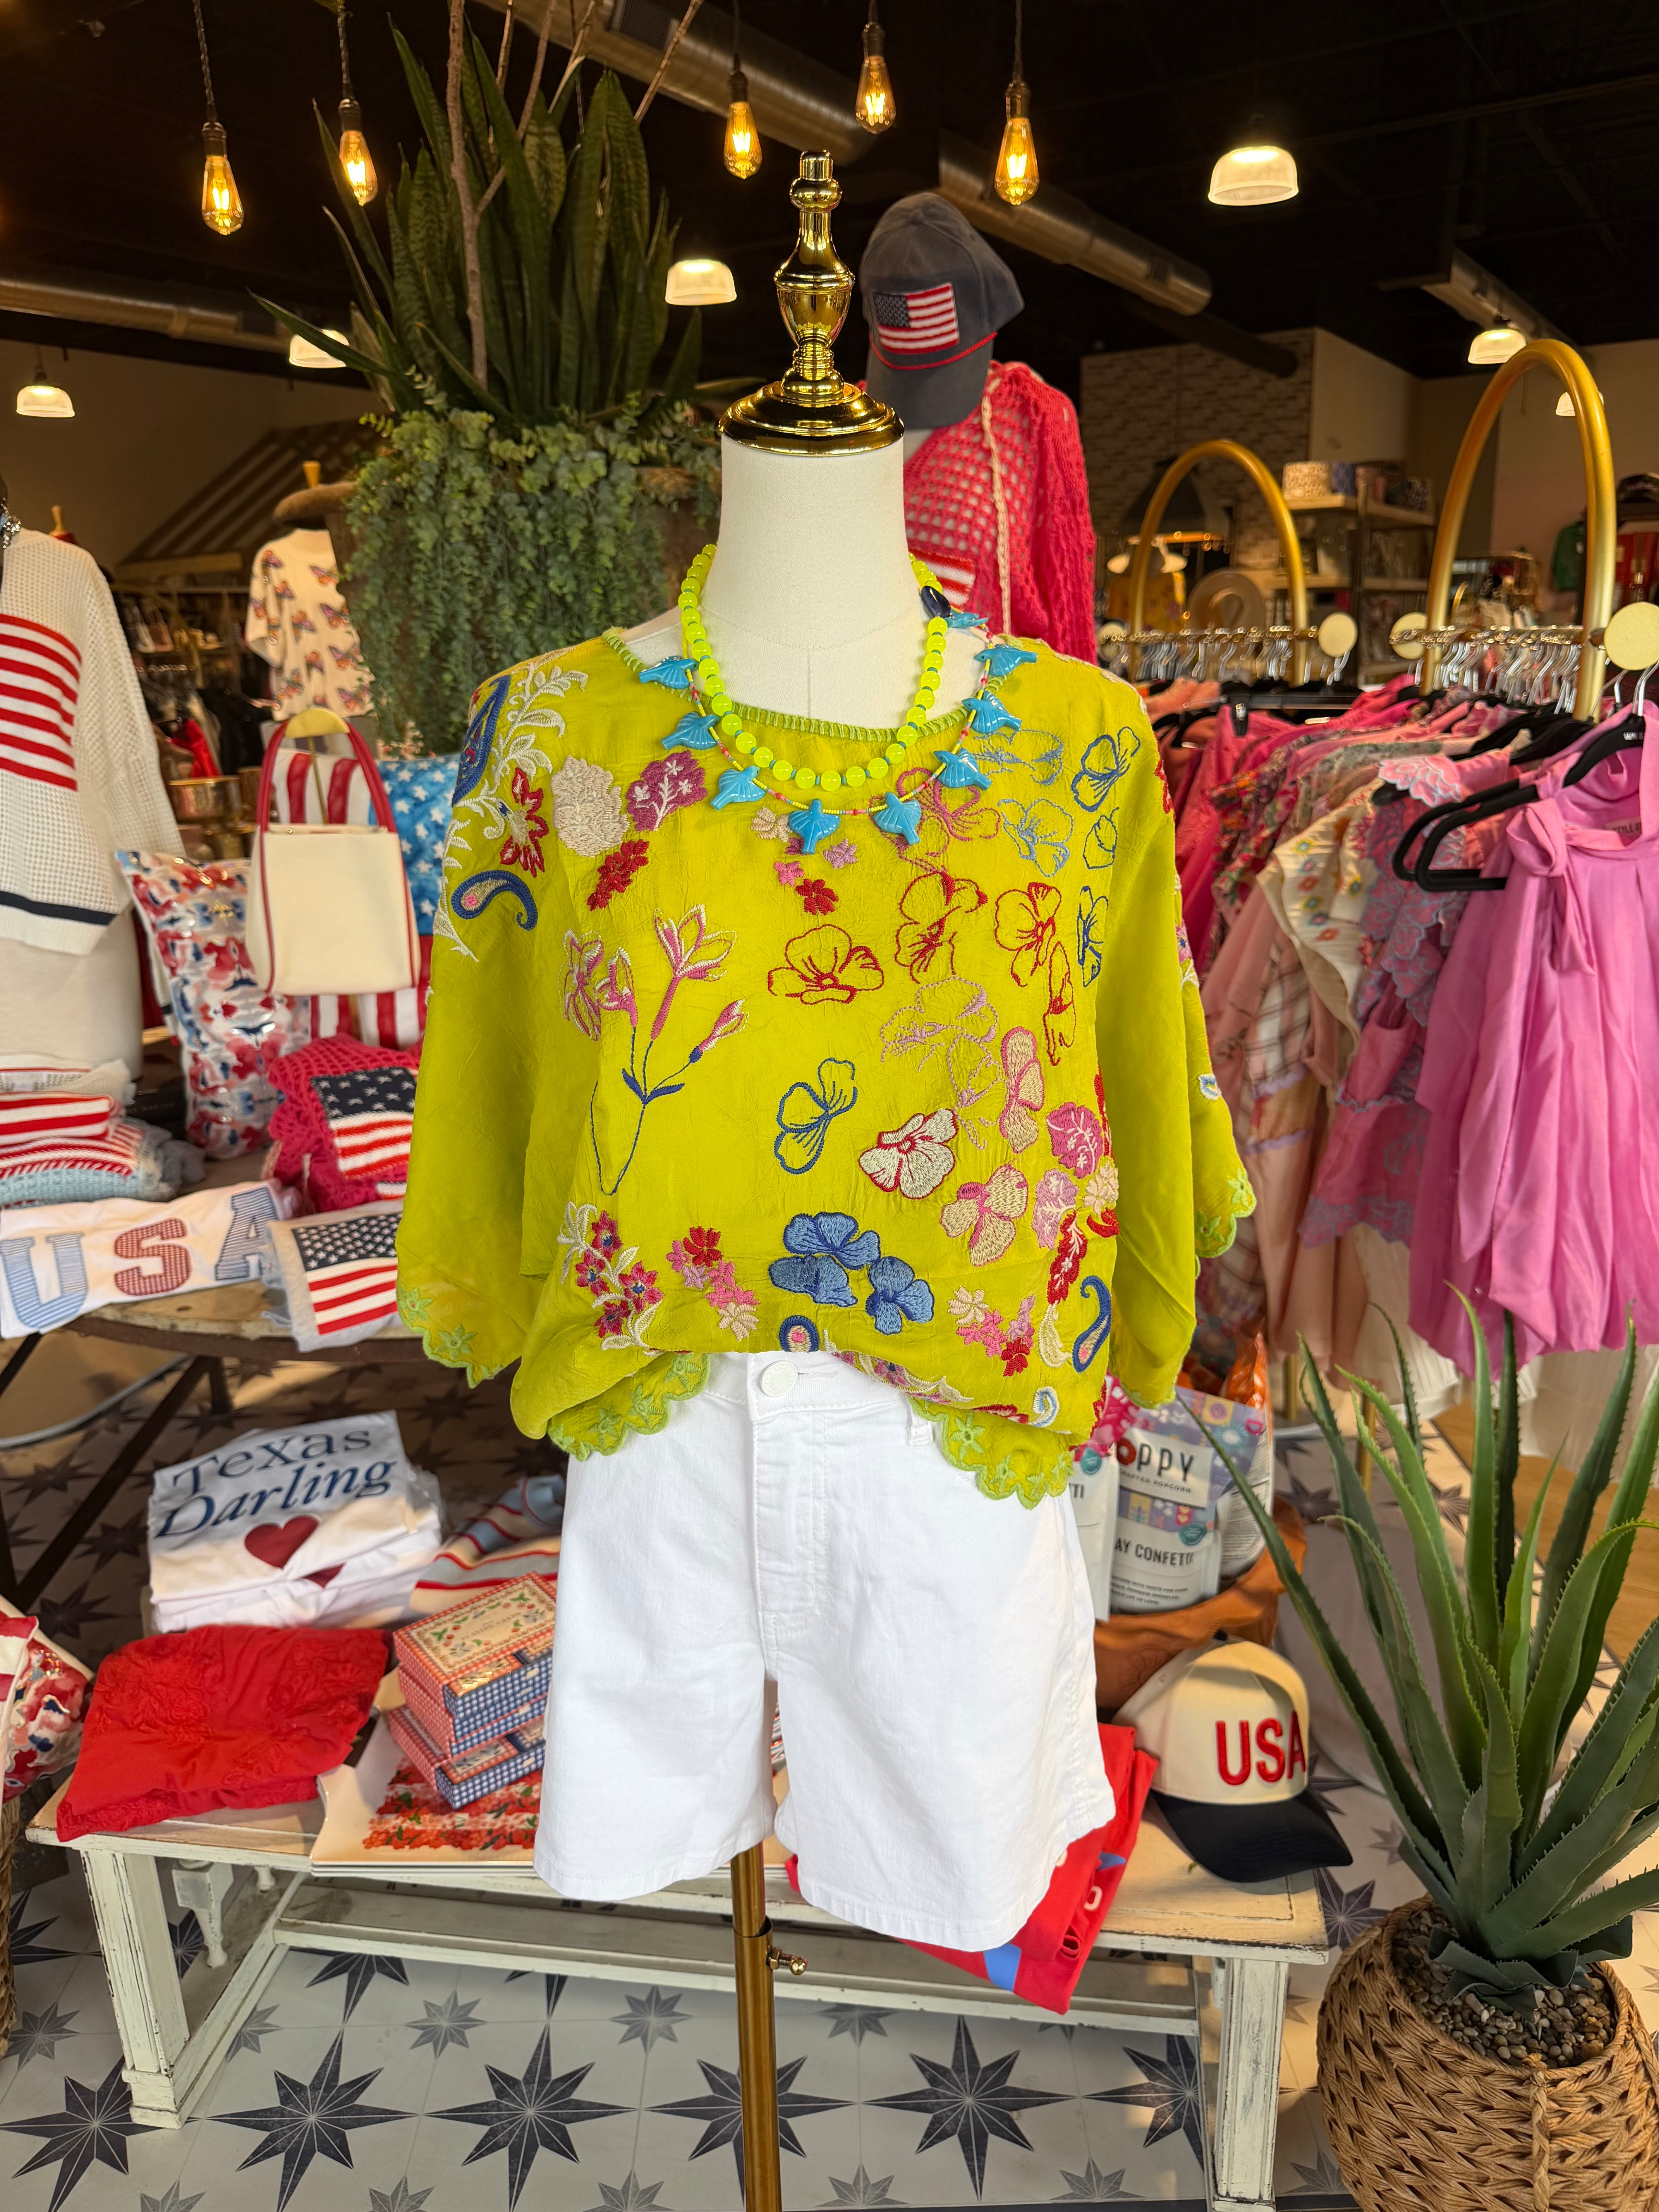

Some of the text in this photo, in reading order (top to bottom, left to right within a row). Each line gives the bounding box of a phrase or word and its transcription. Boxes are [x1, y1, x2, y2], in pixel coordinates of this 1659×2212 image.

[0, 1187, 280, 1329] USA
[155, 1460, 397, 1540] Darling
[172, 1429, 372, 1499] Texas
[1135, 1543, 1194, 1566] CONFETTI
[1215, 1711, 1306, 1787] USA
